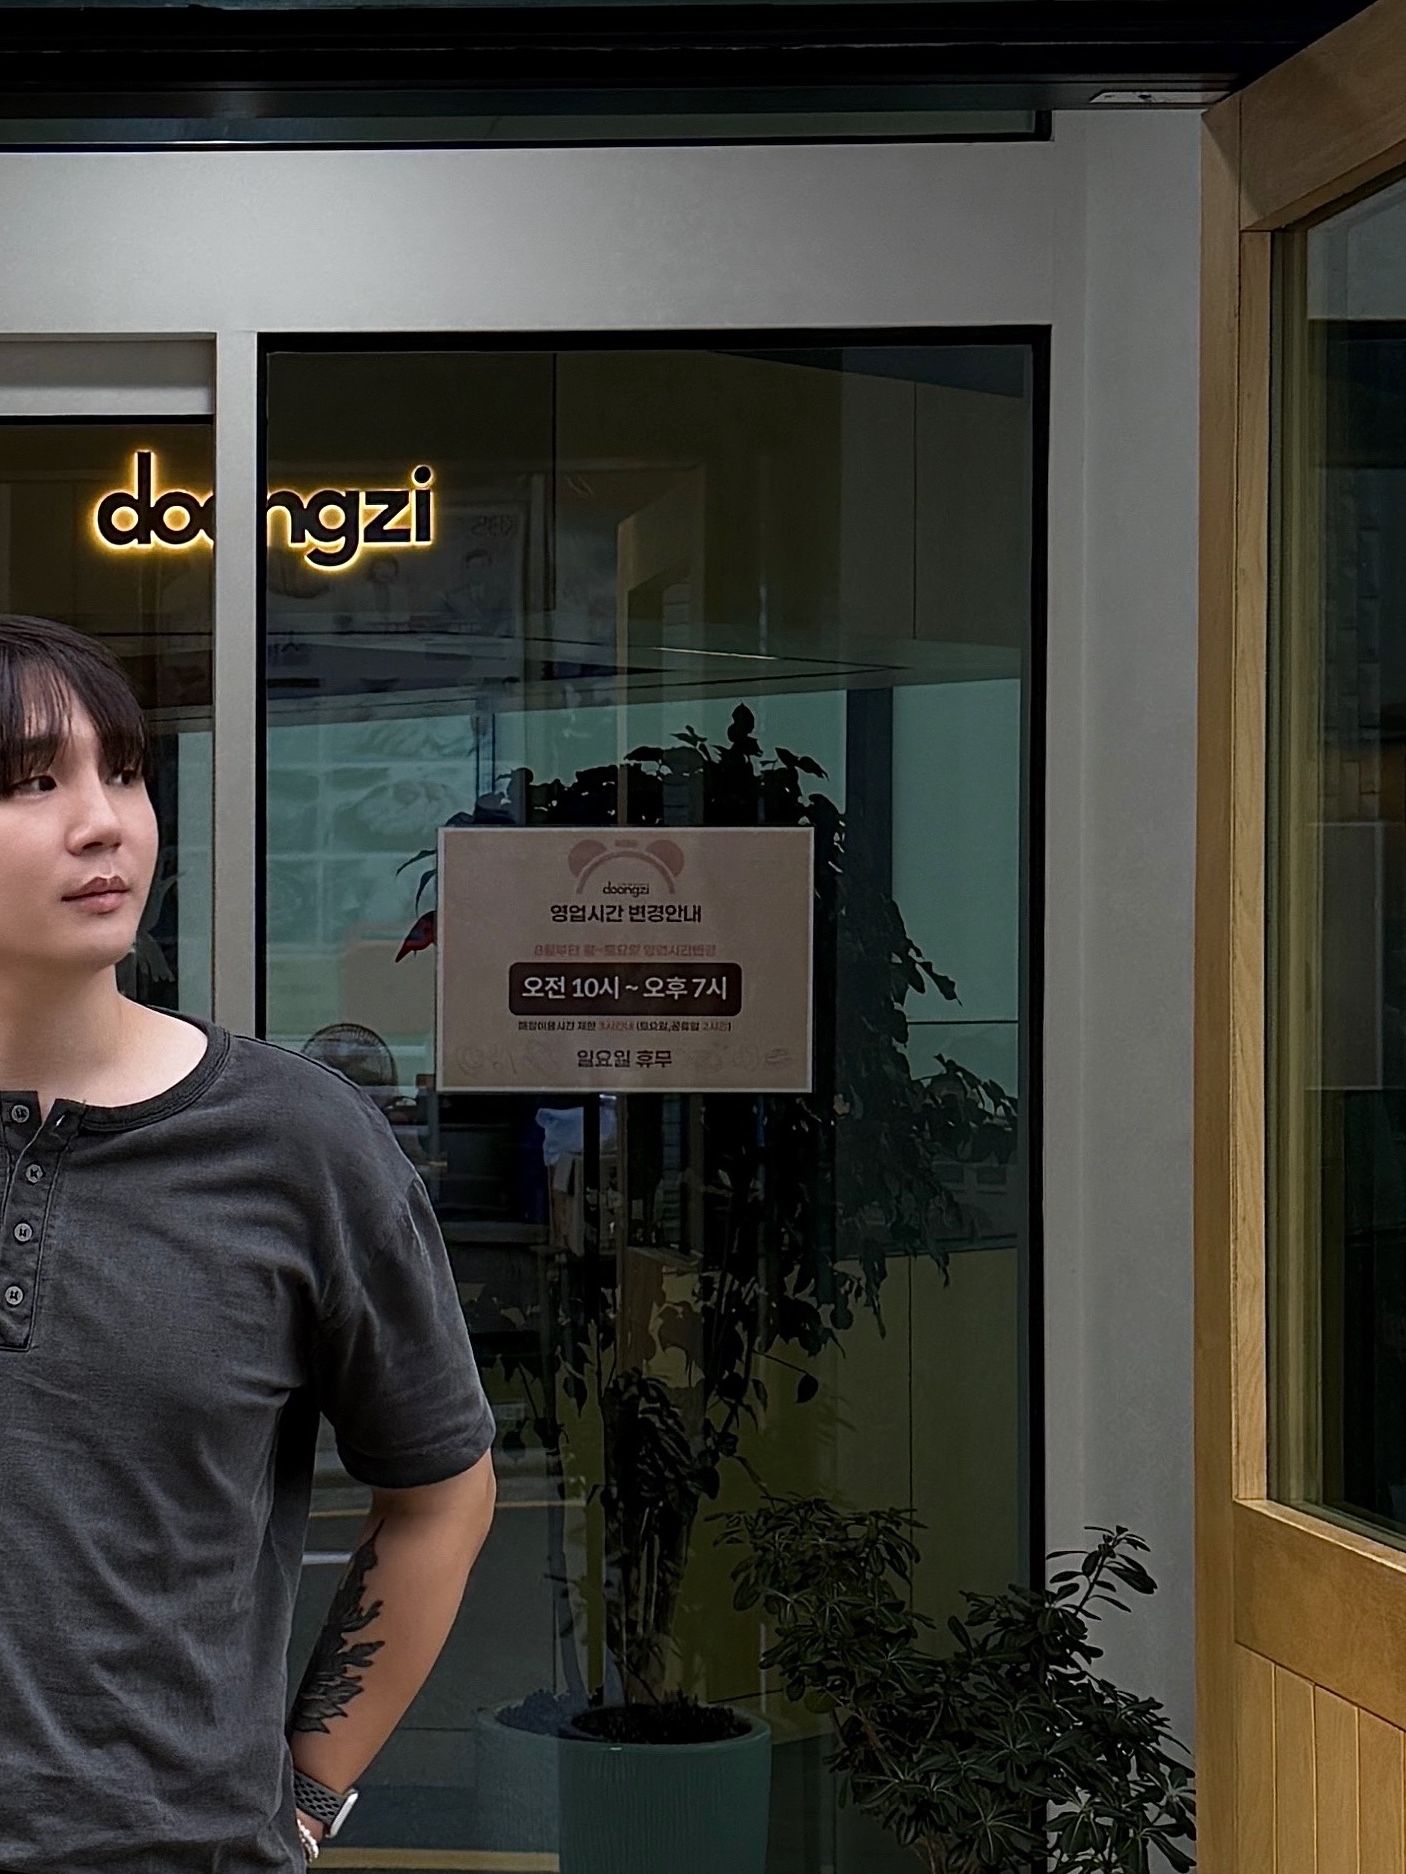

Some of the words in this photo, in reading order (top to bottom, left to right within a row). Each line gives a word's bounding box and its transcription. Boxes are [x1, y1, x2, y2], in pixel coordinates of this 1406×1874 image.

[602, 881, 650, 898] doongzi
[550, 904, 624, 923] 영업시간
[628, 904, 702, 923] 변경안내
[521, 976, 566, 1000] 오전
[571, 976, 620, 1000] 10시
[642, 976, 688, 1000] 오후
[692, 976, 727, 1000] 7시
[577, 1049, 631, 1068] 일요일
[636, 1049, 673, 1068] 휴무
